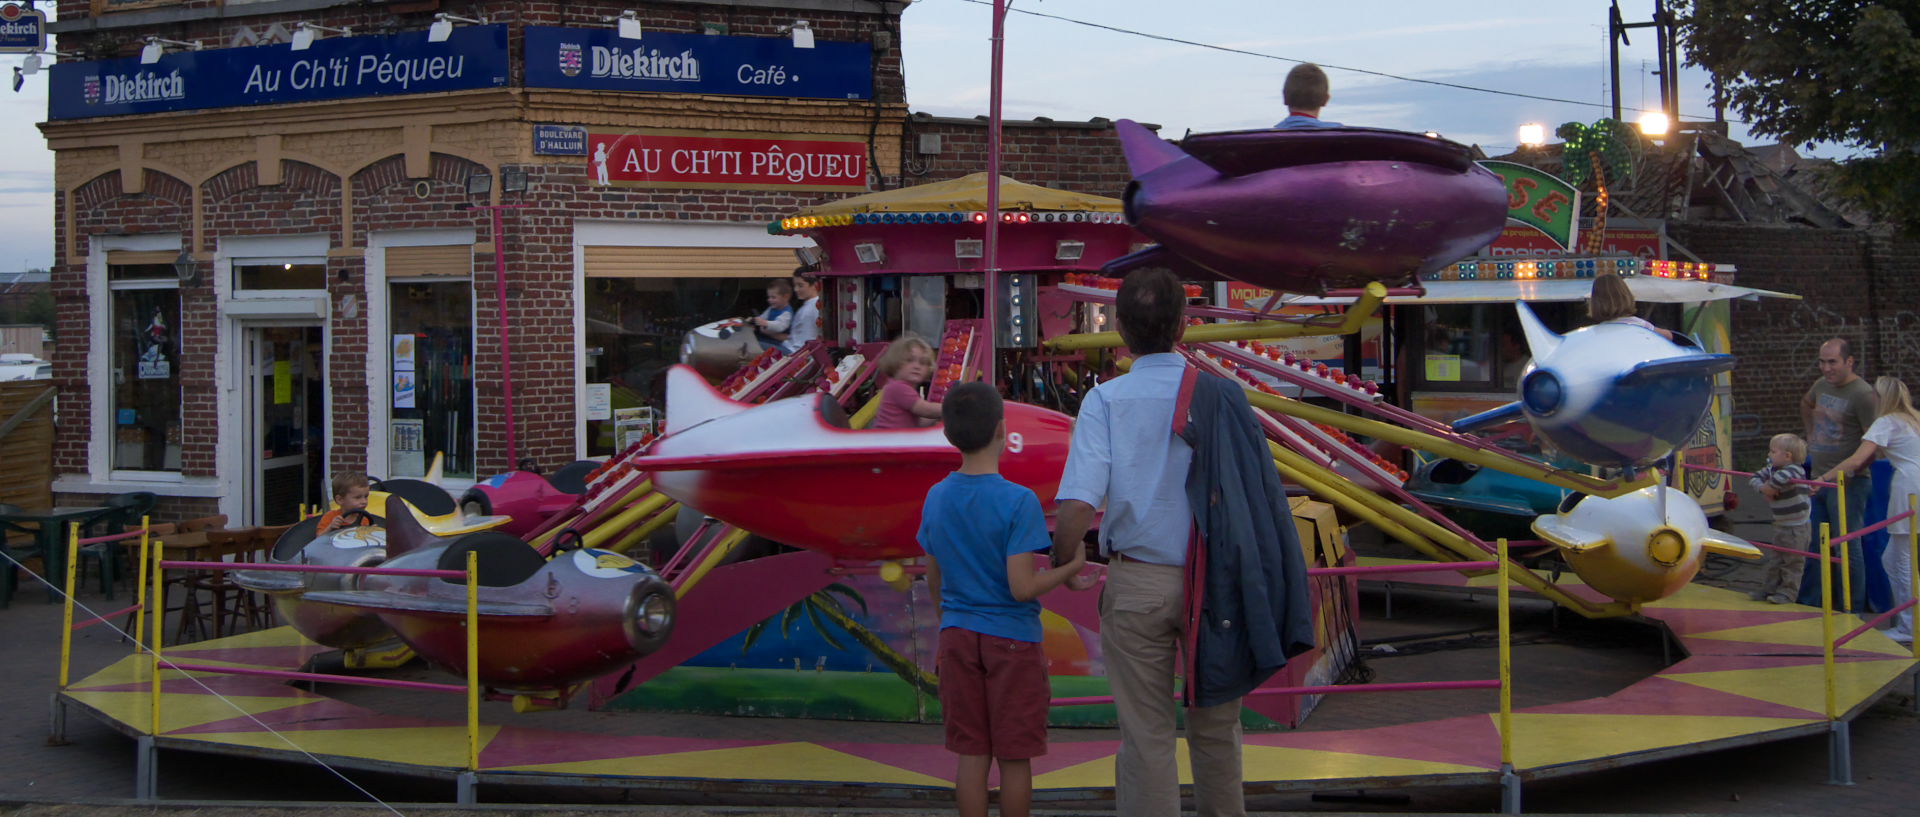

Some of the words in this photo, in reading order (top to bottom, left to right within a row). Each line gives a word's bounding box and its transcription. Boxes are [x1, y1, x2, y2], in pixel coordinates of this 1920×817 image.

[244, 64, 281, 94] Au
[290, 57, 349, 90] Ch'ti
[357, 53, 464, 89] Péqueu
[591, 45, 700, 82] Diekirch
[737, 64, 786, 85] Café
[104, 67, 184, 104] Diekirch
[540, 130, 583, 139] BOULEVARD
[540, 140, 583, 150] D'HALLUIN
[622, 148, 661, 174] AU
[671, 149, 742, 176] CH'TI
[750, 144, 862, 183] PÊQUEU
[1007, 432, 1023, 453] 9
